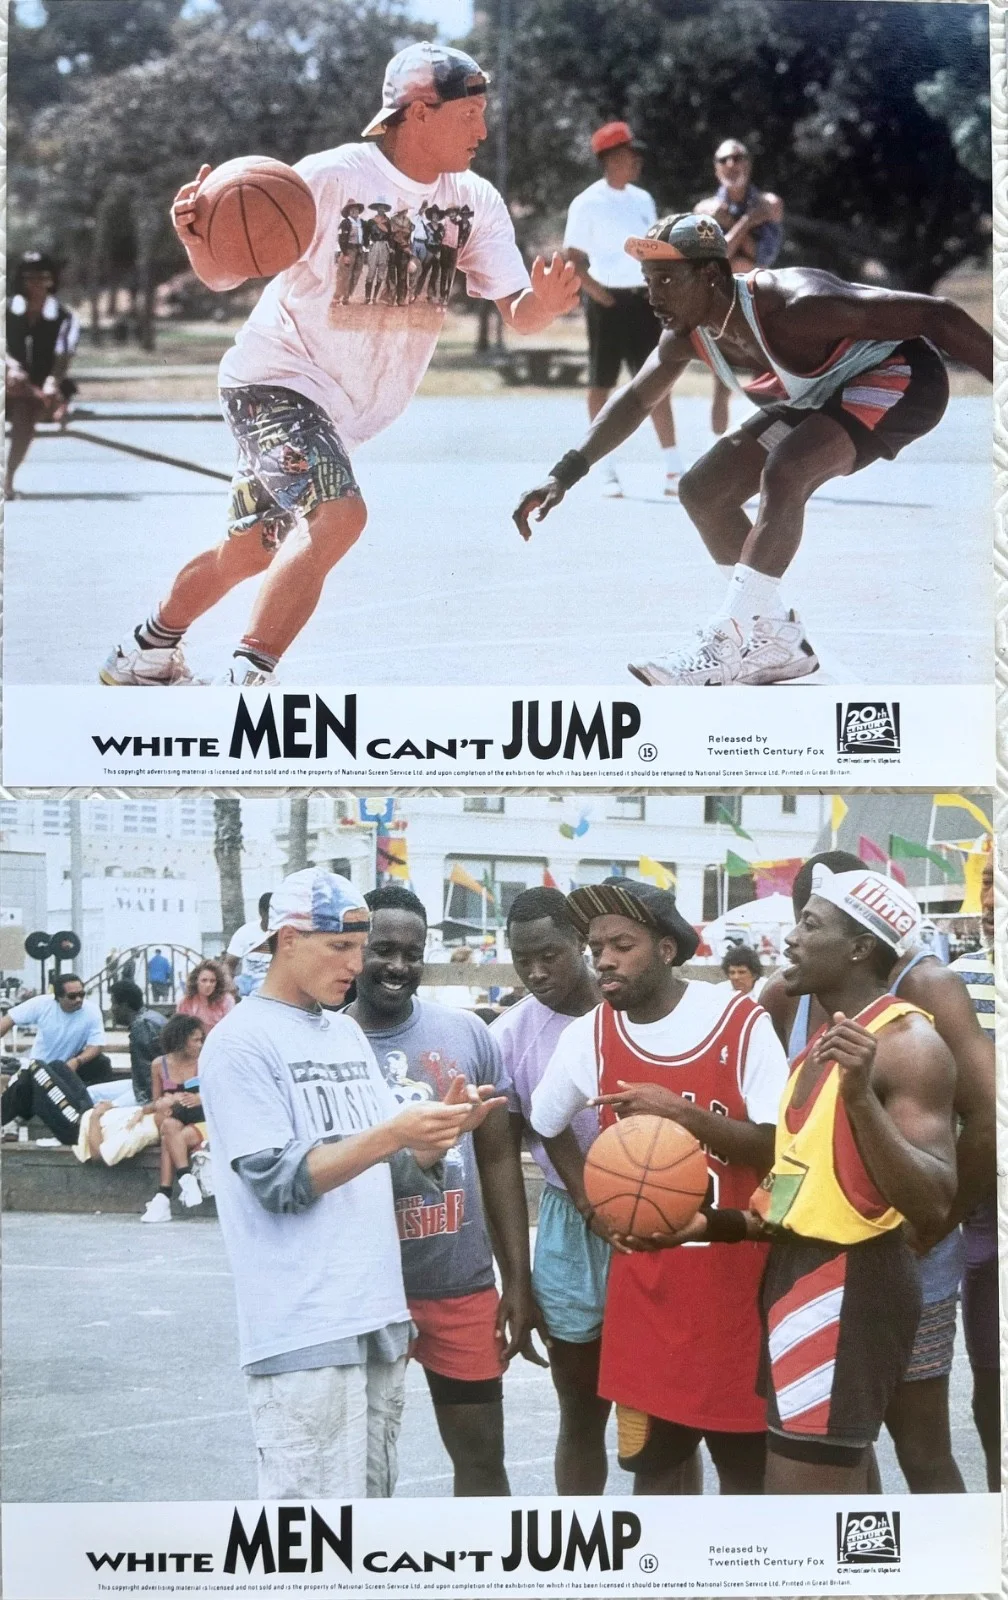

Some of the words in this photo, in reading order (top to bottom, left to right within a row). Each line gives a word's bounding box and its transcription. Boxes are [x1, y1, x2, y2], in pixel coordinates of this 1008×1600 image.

[847, 706, 887, 726] 20th
[92, 736, 220, 758] WHITE
[229, 693, 357, 760] MEN
[366, 738, 494, 760] CAN'T
[501, 700, 641, 761] JUMP
[847, 719, 886, 733] CENTURY
[708, 735, 752, 743] Released
[756, 735, 768, 745] by
[847, 728, 886, 742] FOX
[707, 748, 760, 756] Twentieth
[763, 748, 803, 758] Century
[806, 748, 825, 756] Fox
[853, 877, 913, 933] Time
[847, 1515, 887, 1536] 20th
[86, 1551, 214, 1573] WHITE
[223, 1505, 353, 1575] MEN
[362, 1551, 493, 1574] CAN'T
[501, 1510, 642, 1572] JUMP
[847, 1529, 886, 1543] CENTURY
[709, 1545, 753, 1553] Released
[756, 1545, 768, 1555] by
[847, 1537, 886, 1552] FOX
[708, 1558, 760, 1566] Twentieth
[763, 1558, 804, 1567] Century
[807, 1558, 825, 1566] Fox
[451, 1583, 485, 1591] completion
